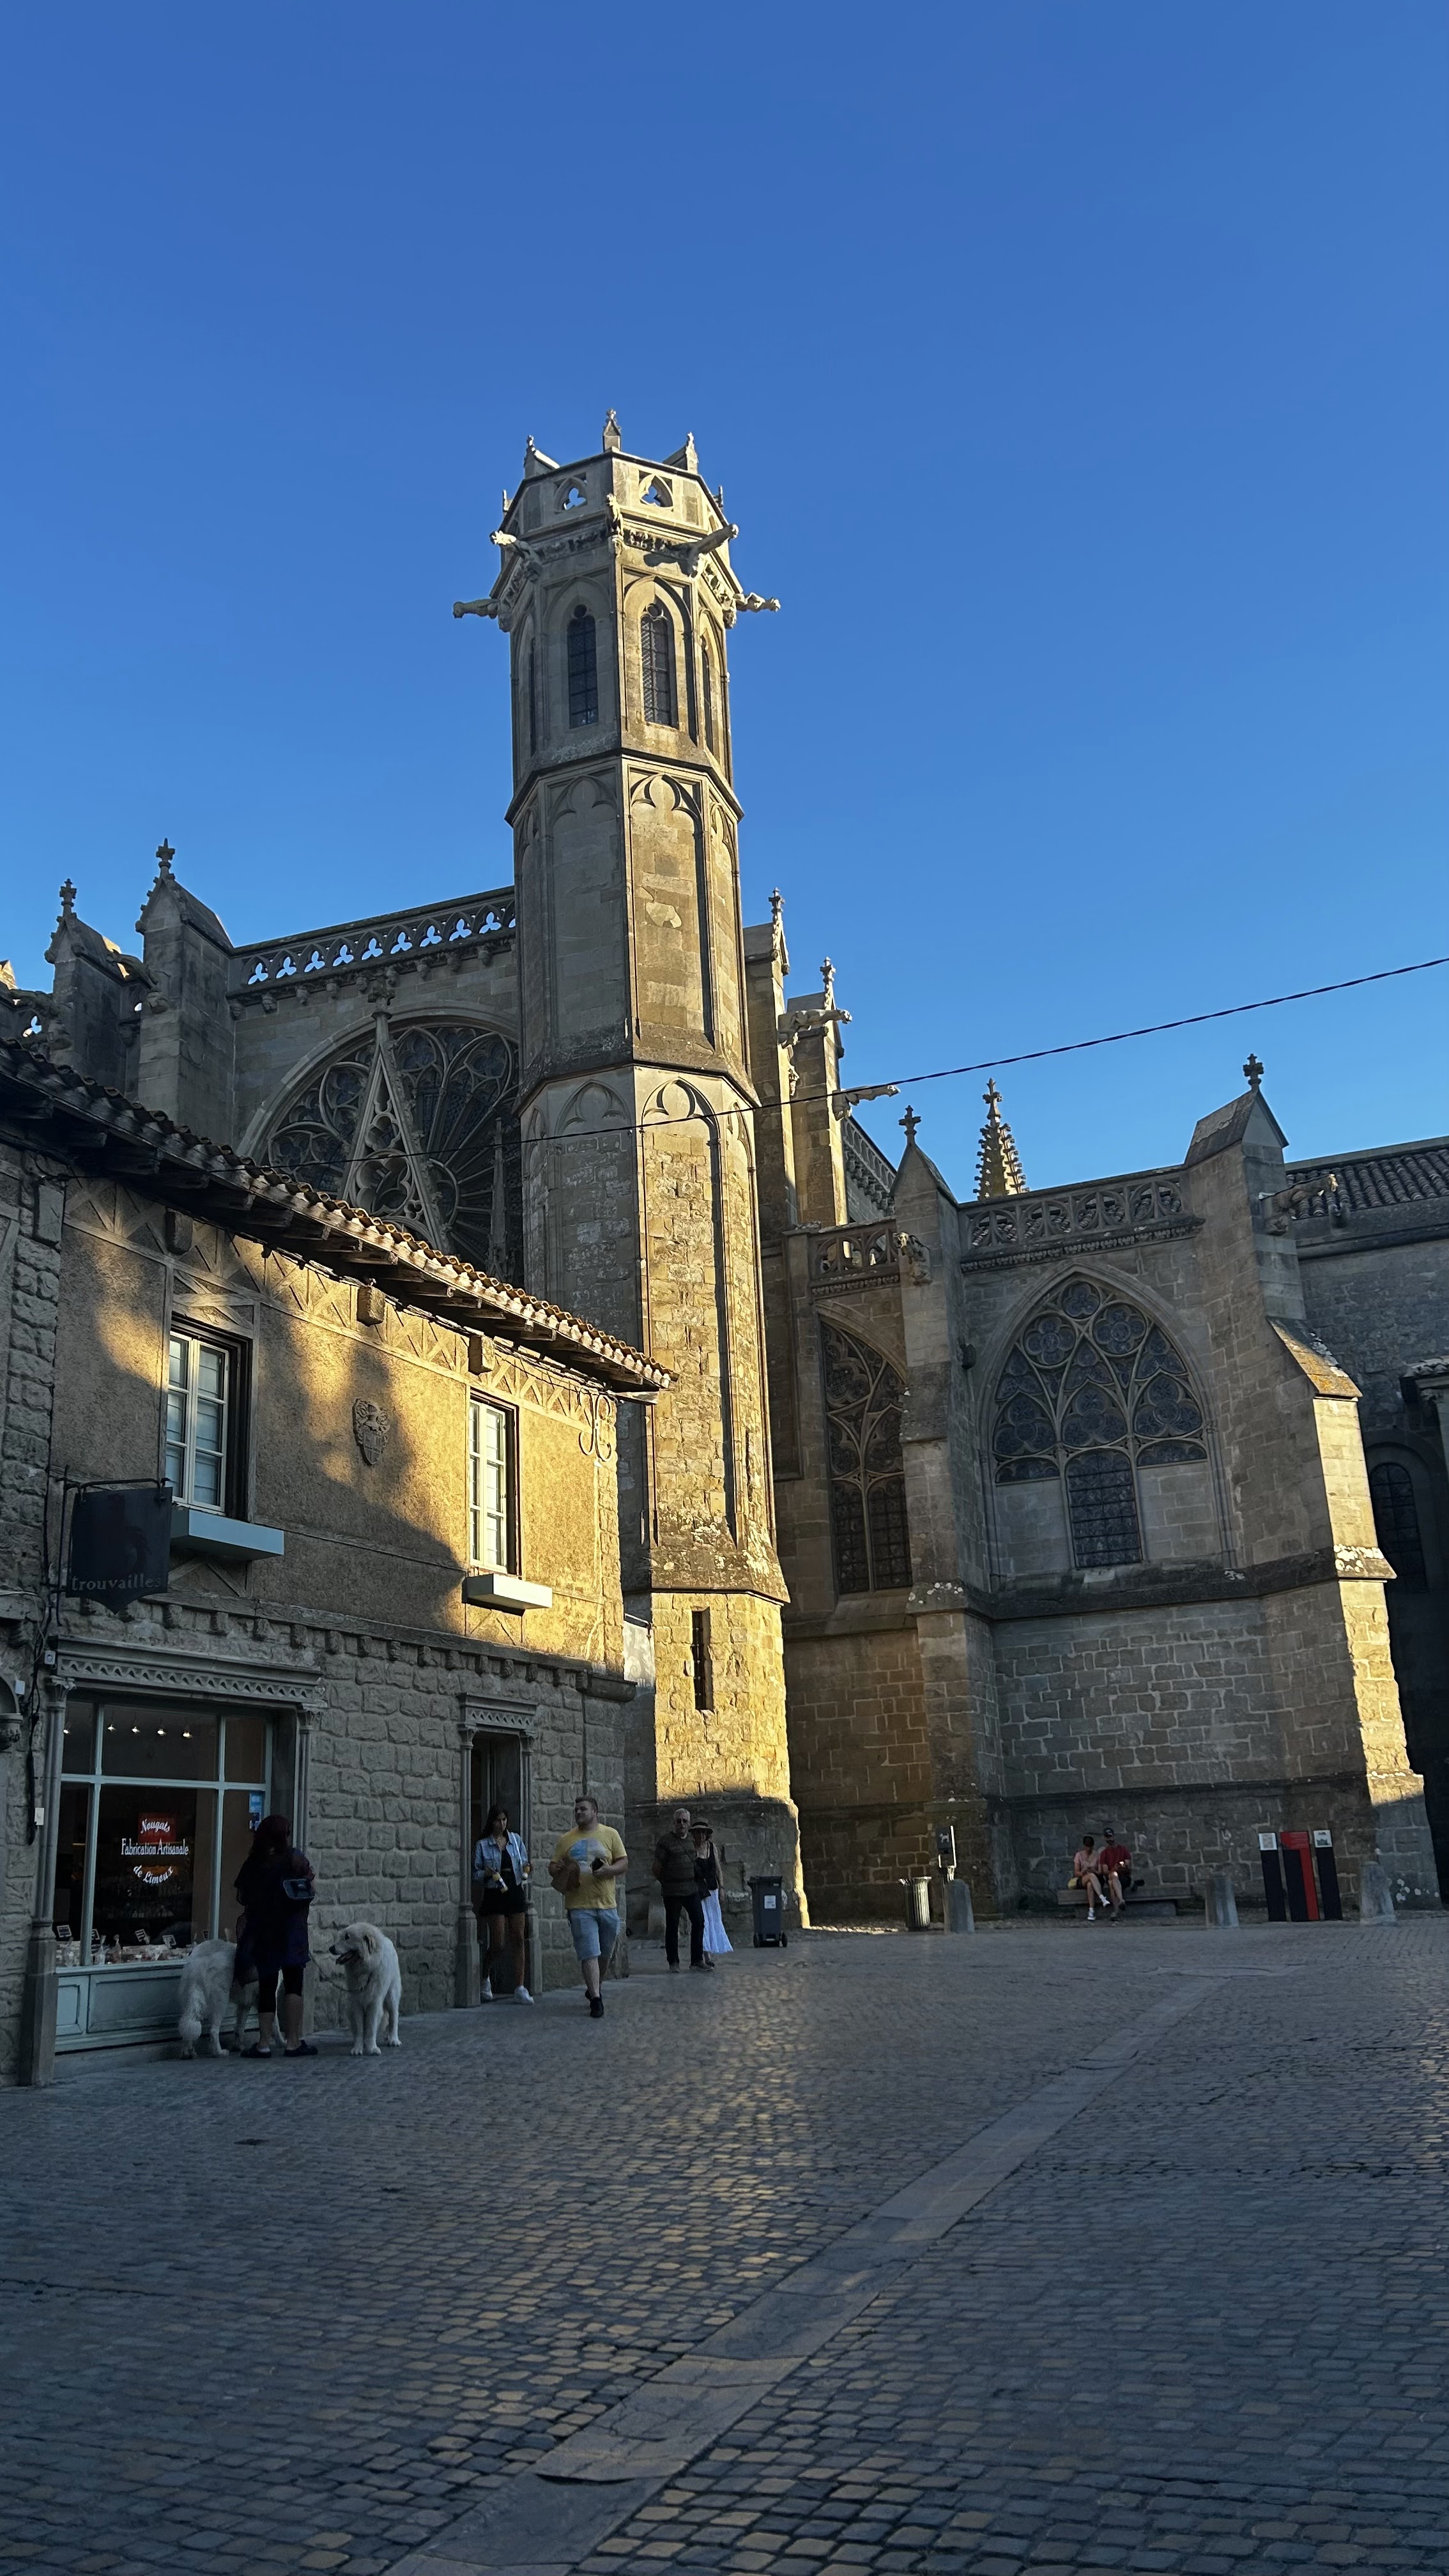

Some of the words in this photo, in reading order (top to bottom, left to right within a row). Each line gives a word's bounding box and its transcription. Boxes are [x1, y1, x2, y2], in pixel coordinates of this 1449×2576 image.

[72, 1573, 162, 1591] trouvailles
[141, 1818, 171, 1834] Nougats
[121, 1837, 156, 1855] Fabrication
[157, 1838, 189, 1856] Artisanale
[133, 1865, 143, 1878] de
[142, 1866, 174, 1884] Limoux
